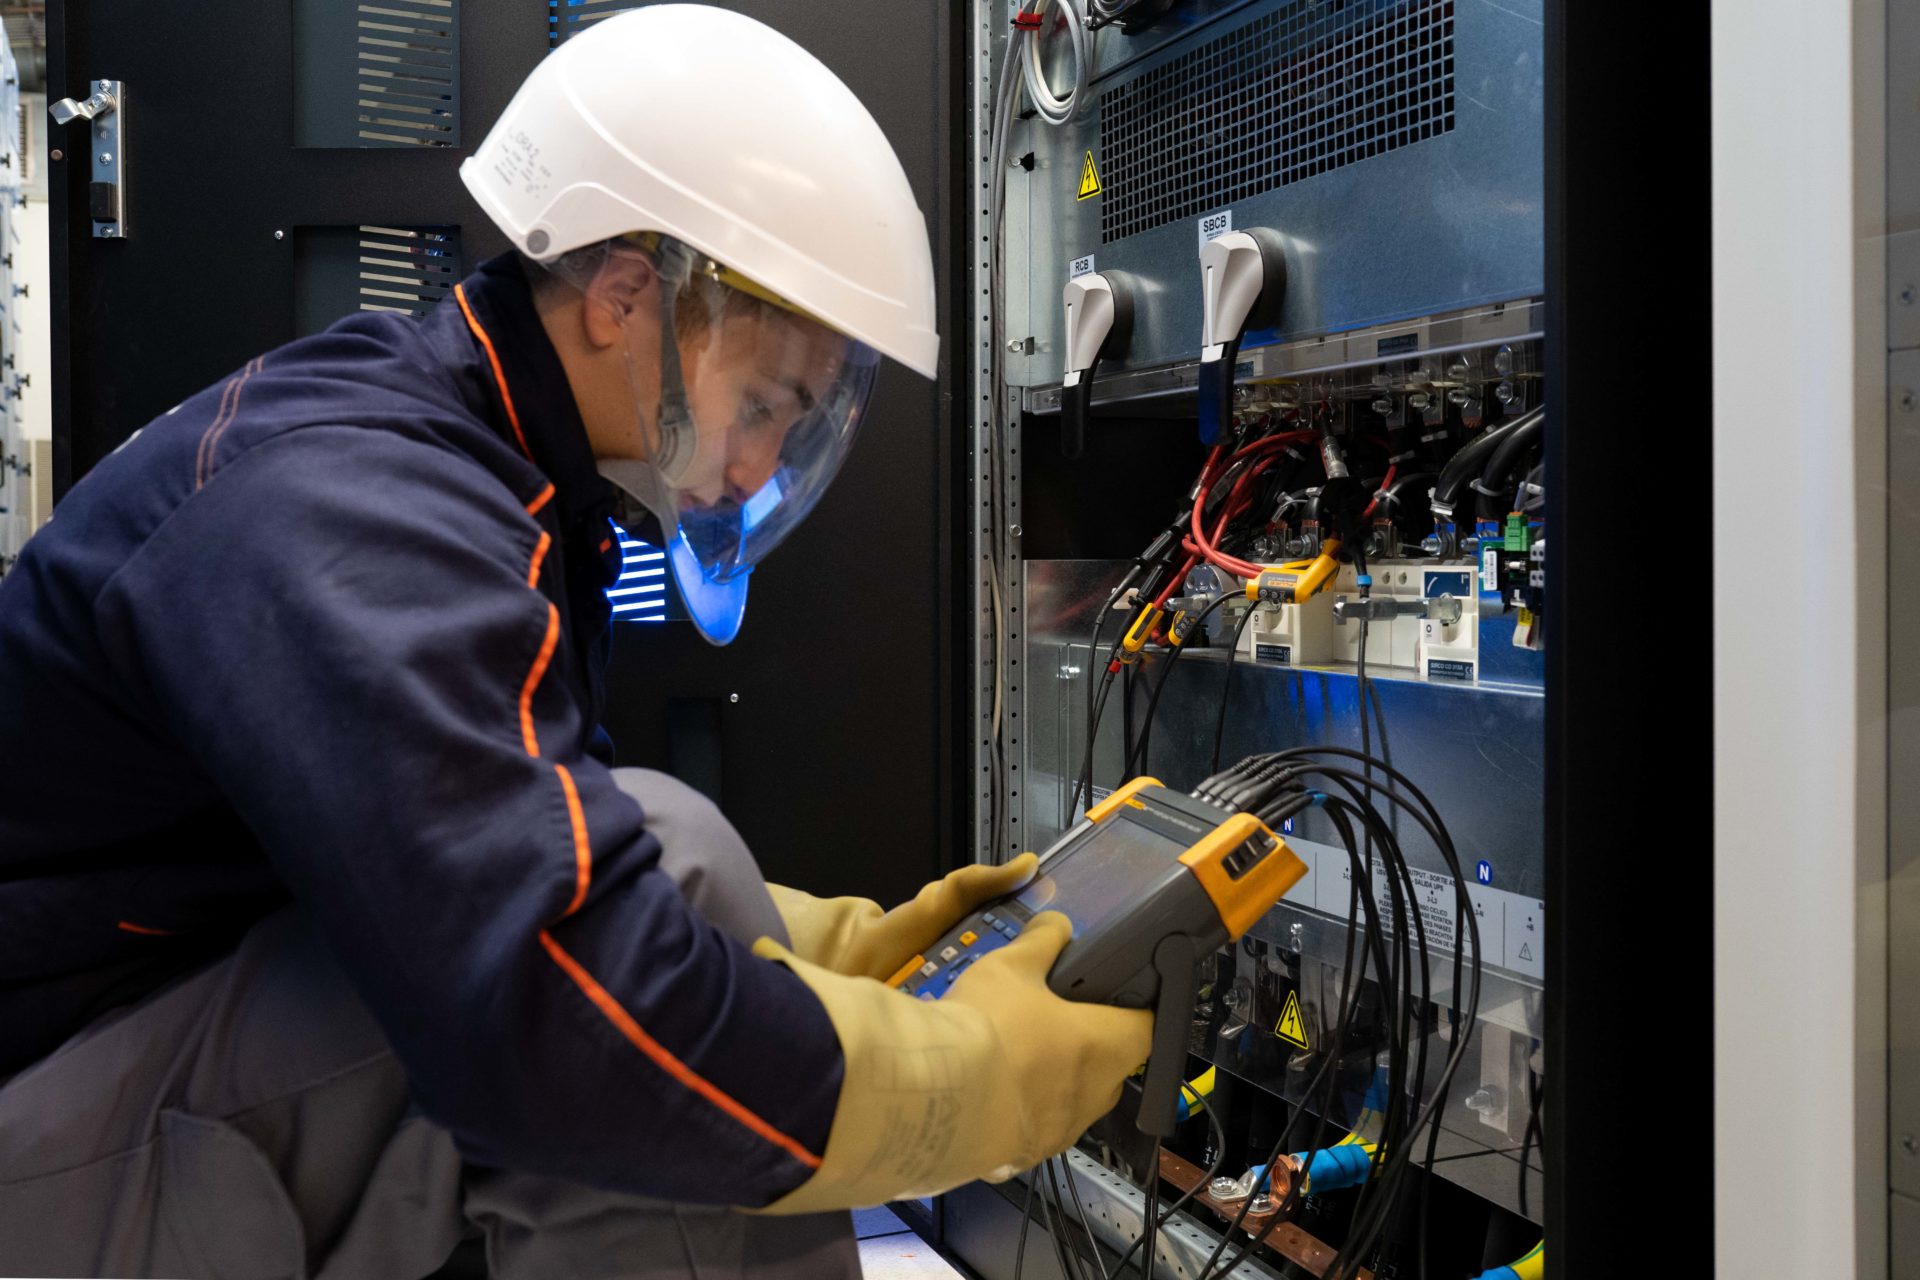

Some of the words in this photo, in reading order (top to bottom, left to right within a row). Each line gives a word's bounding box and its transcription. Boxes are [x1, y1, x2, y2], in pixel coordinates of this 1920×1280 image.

[1203, 215, 1227, 233] SBCB
[1075, 259, 1089, 272] RCB
[1284, 818, 1292, 832] N
[1408, 869, 1426, 879] UTPUT
[1480, 864, 1490, 882] N
[1414, 878, 1433, 889] SALIDA
[1433, 882, 1444, 891] UPS
